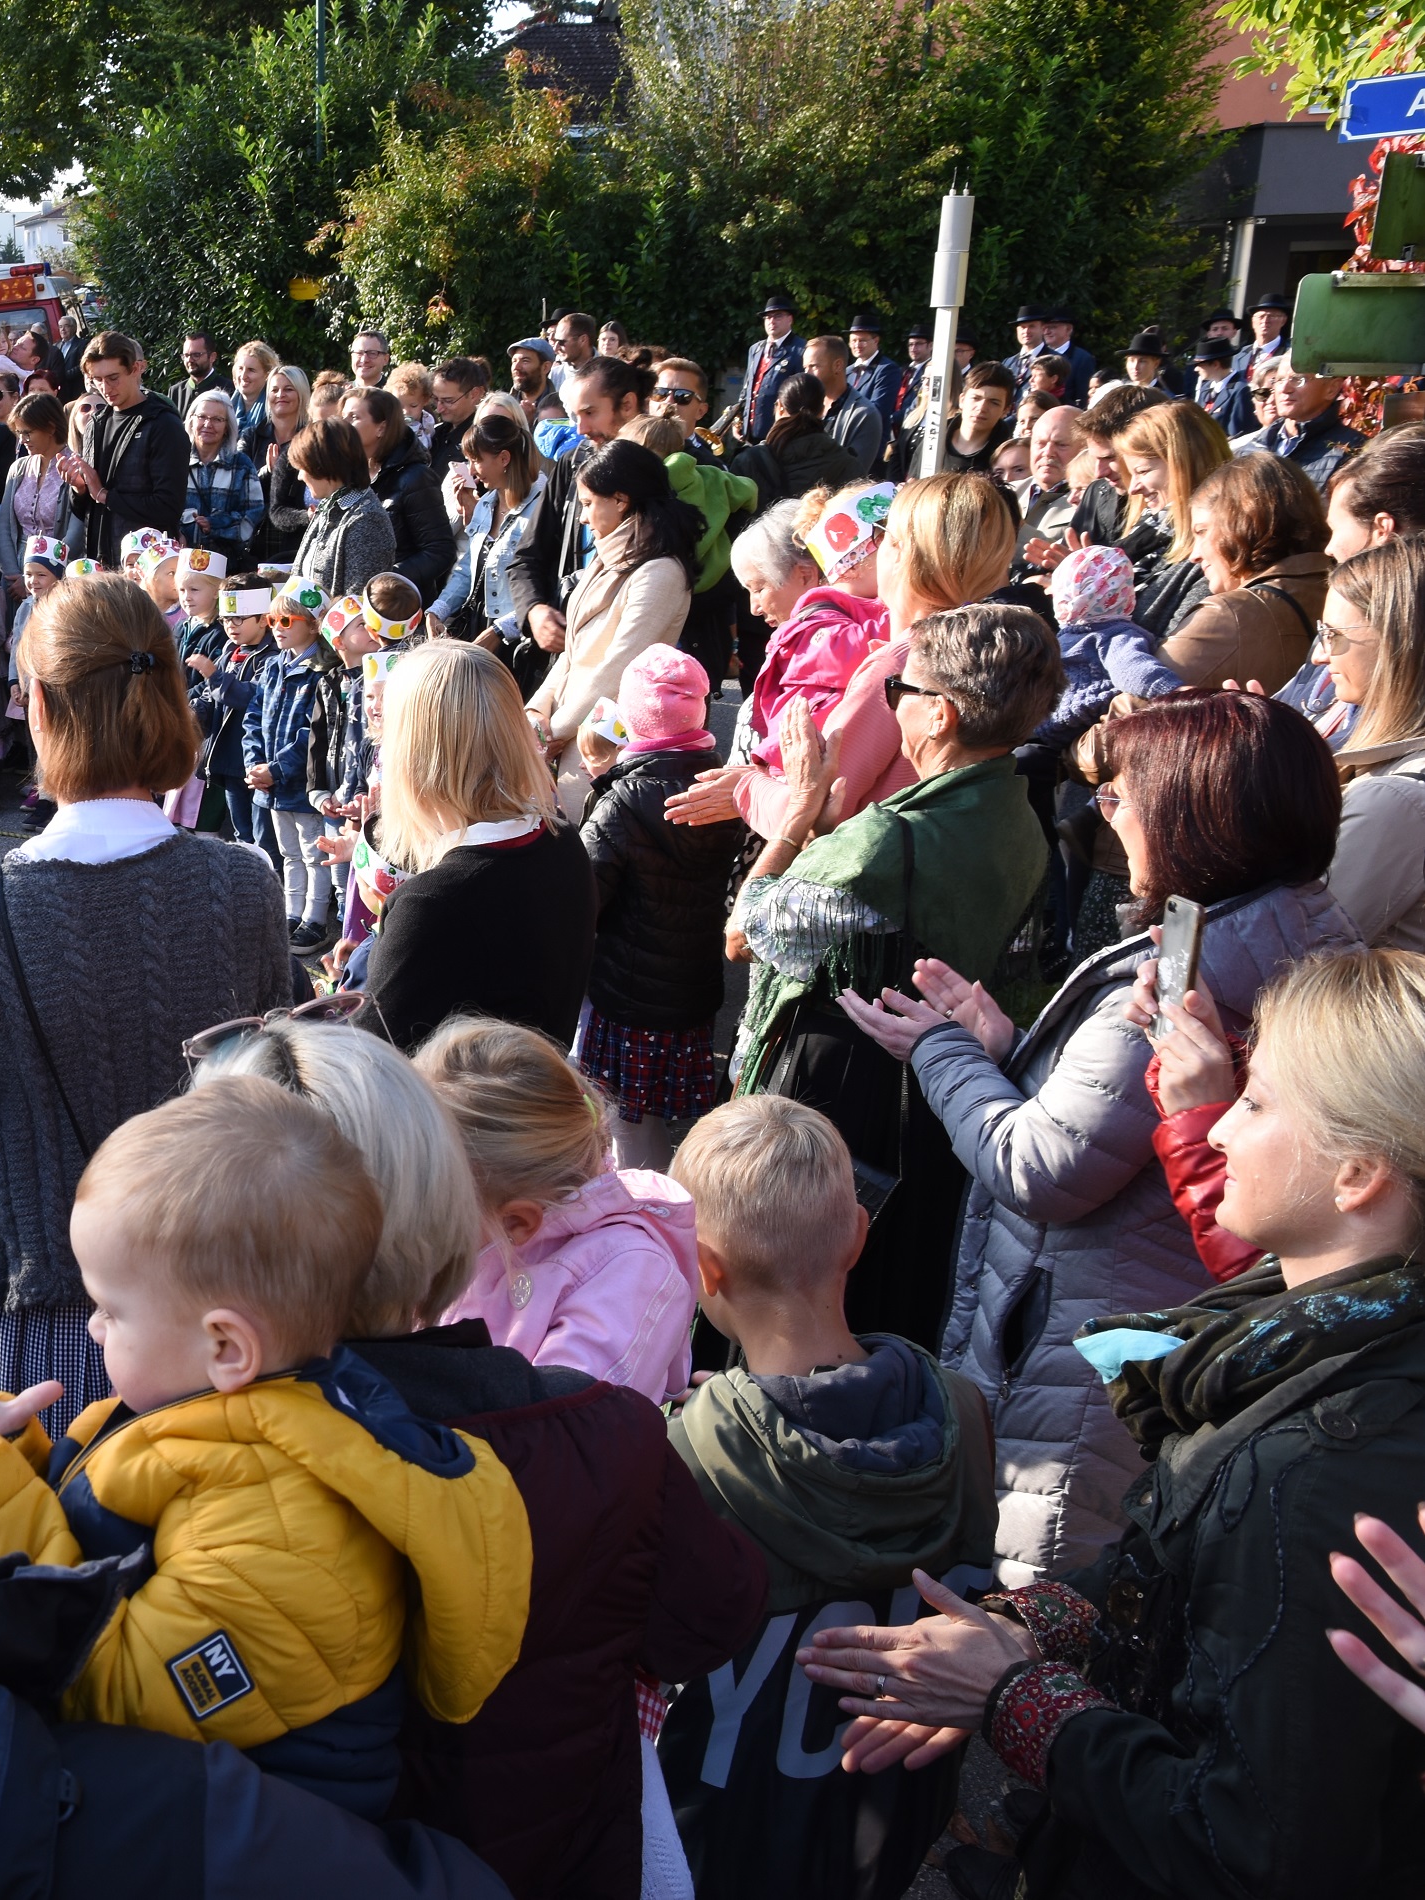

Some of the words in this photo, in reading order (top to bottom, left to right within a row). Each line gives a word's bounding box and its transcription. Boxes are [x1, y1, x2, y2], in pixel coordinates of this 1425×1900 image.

[205, 1643, 236, 1677] NY
[181, 1668, 207, 1707] ACCESS
[191, 1661, 216, 1703] GLOBAL
